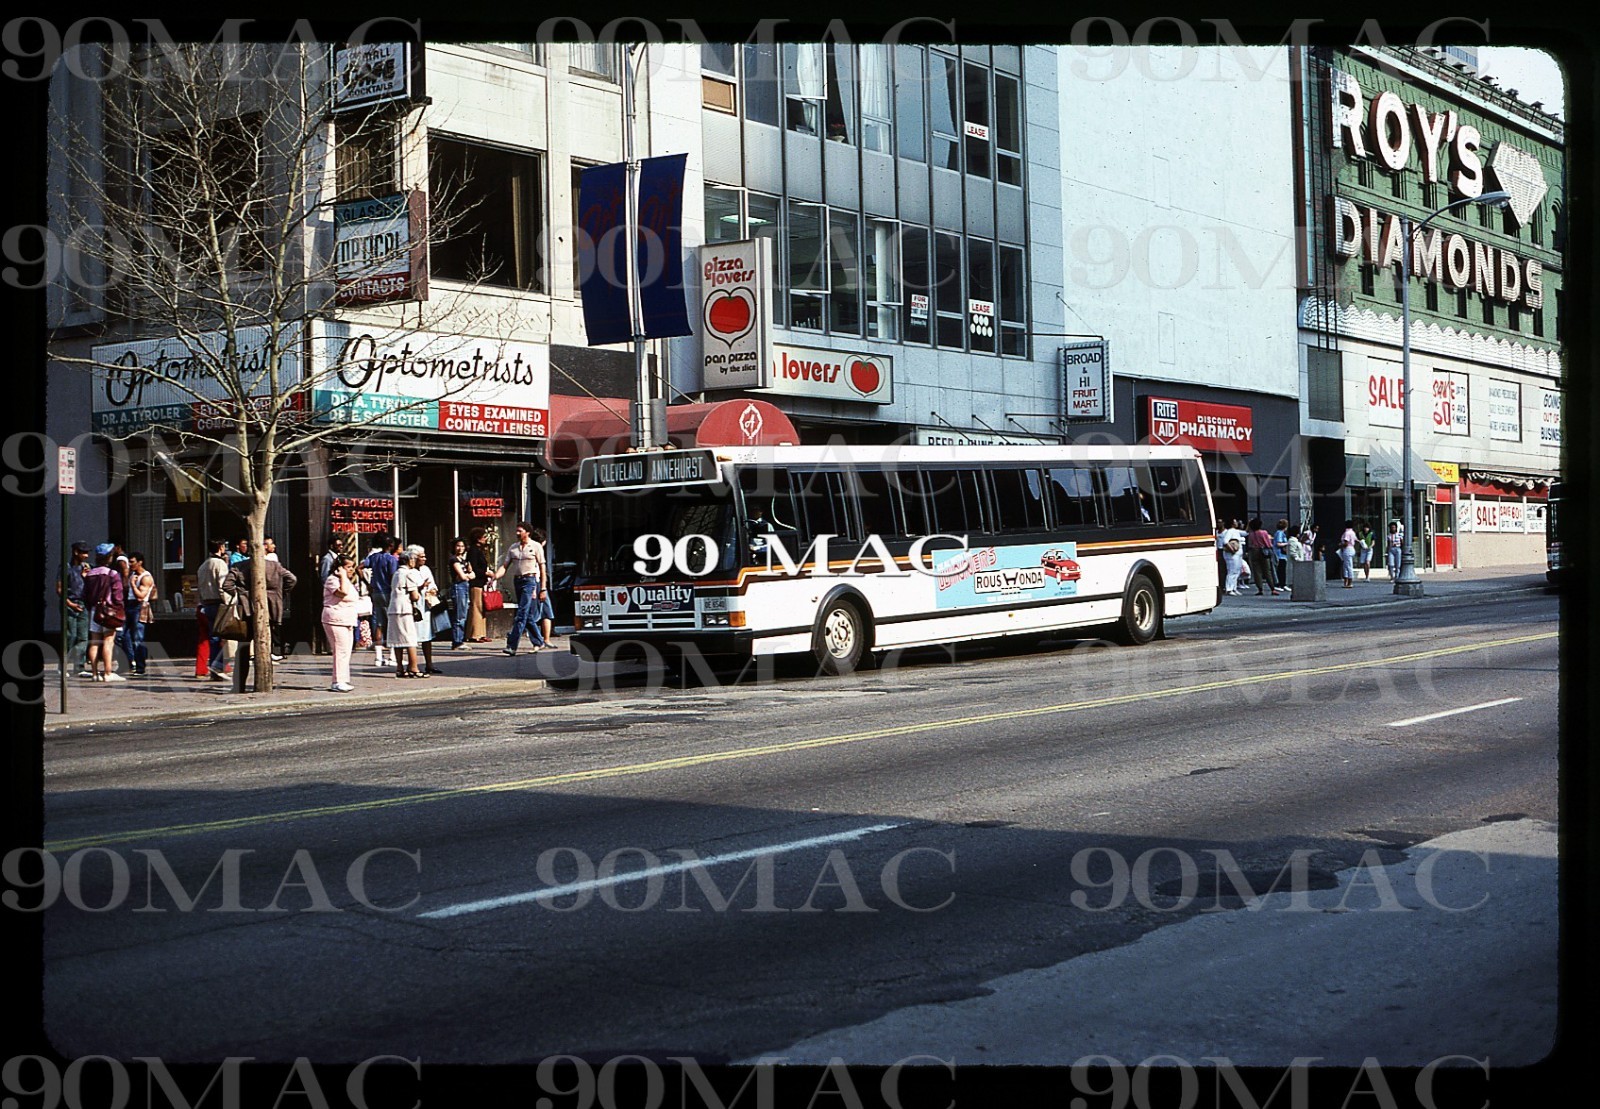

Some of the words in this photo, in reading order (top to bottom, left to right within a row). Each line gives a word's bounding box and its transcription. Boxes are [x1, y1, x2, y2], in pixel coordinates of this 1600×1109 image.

[966, 125, 986, 138] LEASE
[1330, 66, 1484, 199] ROY'S
[1334, 196, 1544, 310] DIAMONDS
[711, 269, 755, 287] lovers
[340, 277, 405, 297] CONTACTS
[971, 303, 991, 314] LEASE
[337, 334, 533, 392] Optometrists
[705, 354, 726, 366] pan
[728, 351, 757, 364] pizza
[1067, 352, 1101, 365] BROAD
[720, 366, 728, 375] by
[782, 352, 841, 383] lovers
[1079, 377, 1090, 388] HI
[1073, 389, 1098, 399] FRUIT
[102, 413, 118, 425] DR.
[132, 407, 180, 421] TYROLER
[450, 403, 479, 417] EYES
[484, 406, 541, 423] EXAMINED
[1156, 403, 1176, 418] RITE
[445, 418, 499, 433] CONTACT
[503, 422, 546, 436] LENSES
[1197, 415, 1237, 426] DISCOUNT
[1158, 422, 1175, 437] AID
[1180, 422, 1252, 440] PHARMACY
[593, 463, 598, 486] 1
[601, 461, 643, 482] CLEVELAND
[652, 457, 703, 480] ANNEHURST
[350, 498, 393, 509] TYROLER
[471, 498, 503, 507] CONTACT
[351, 510, 394, 520] SCHECTER
[472, 509, 502, 517] LENSES
[1476, 506, 1497, 526] SALE
[632, 585, 692, 606] Quality
[581, 605, 600, 614] 8429
